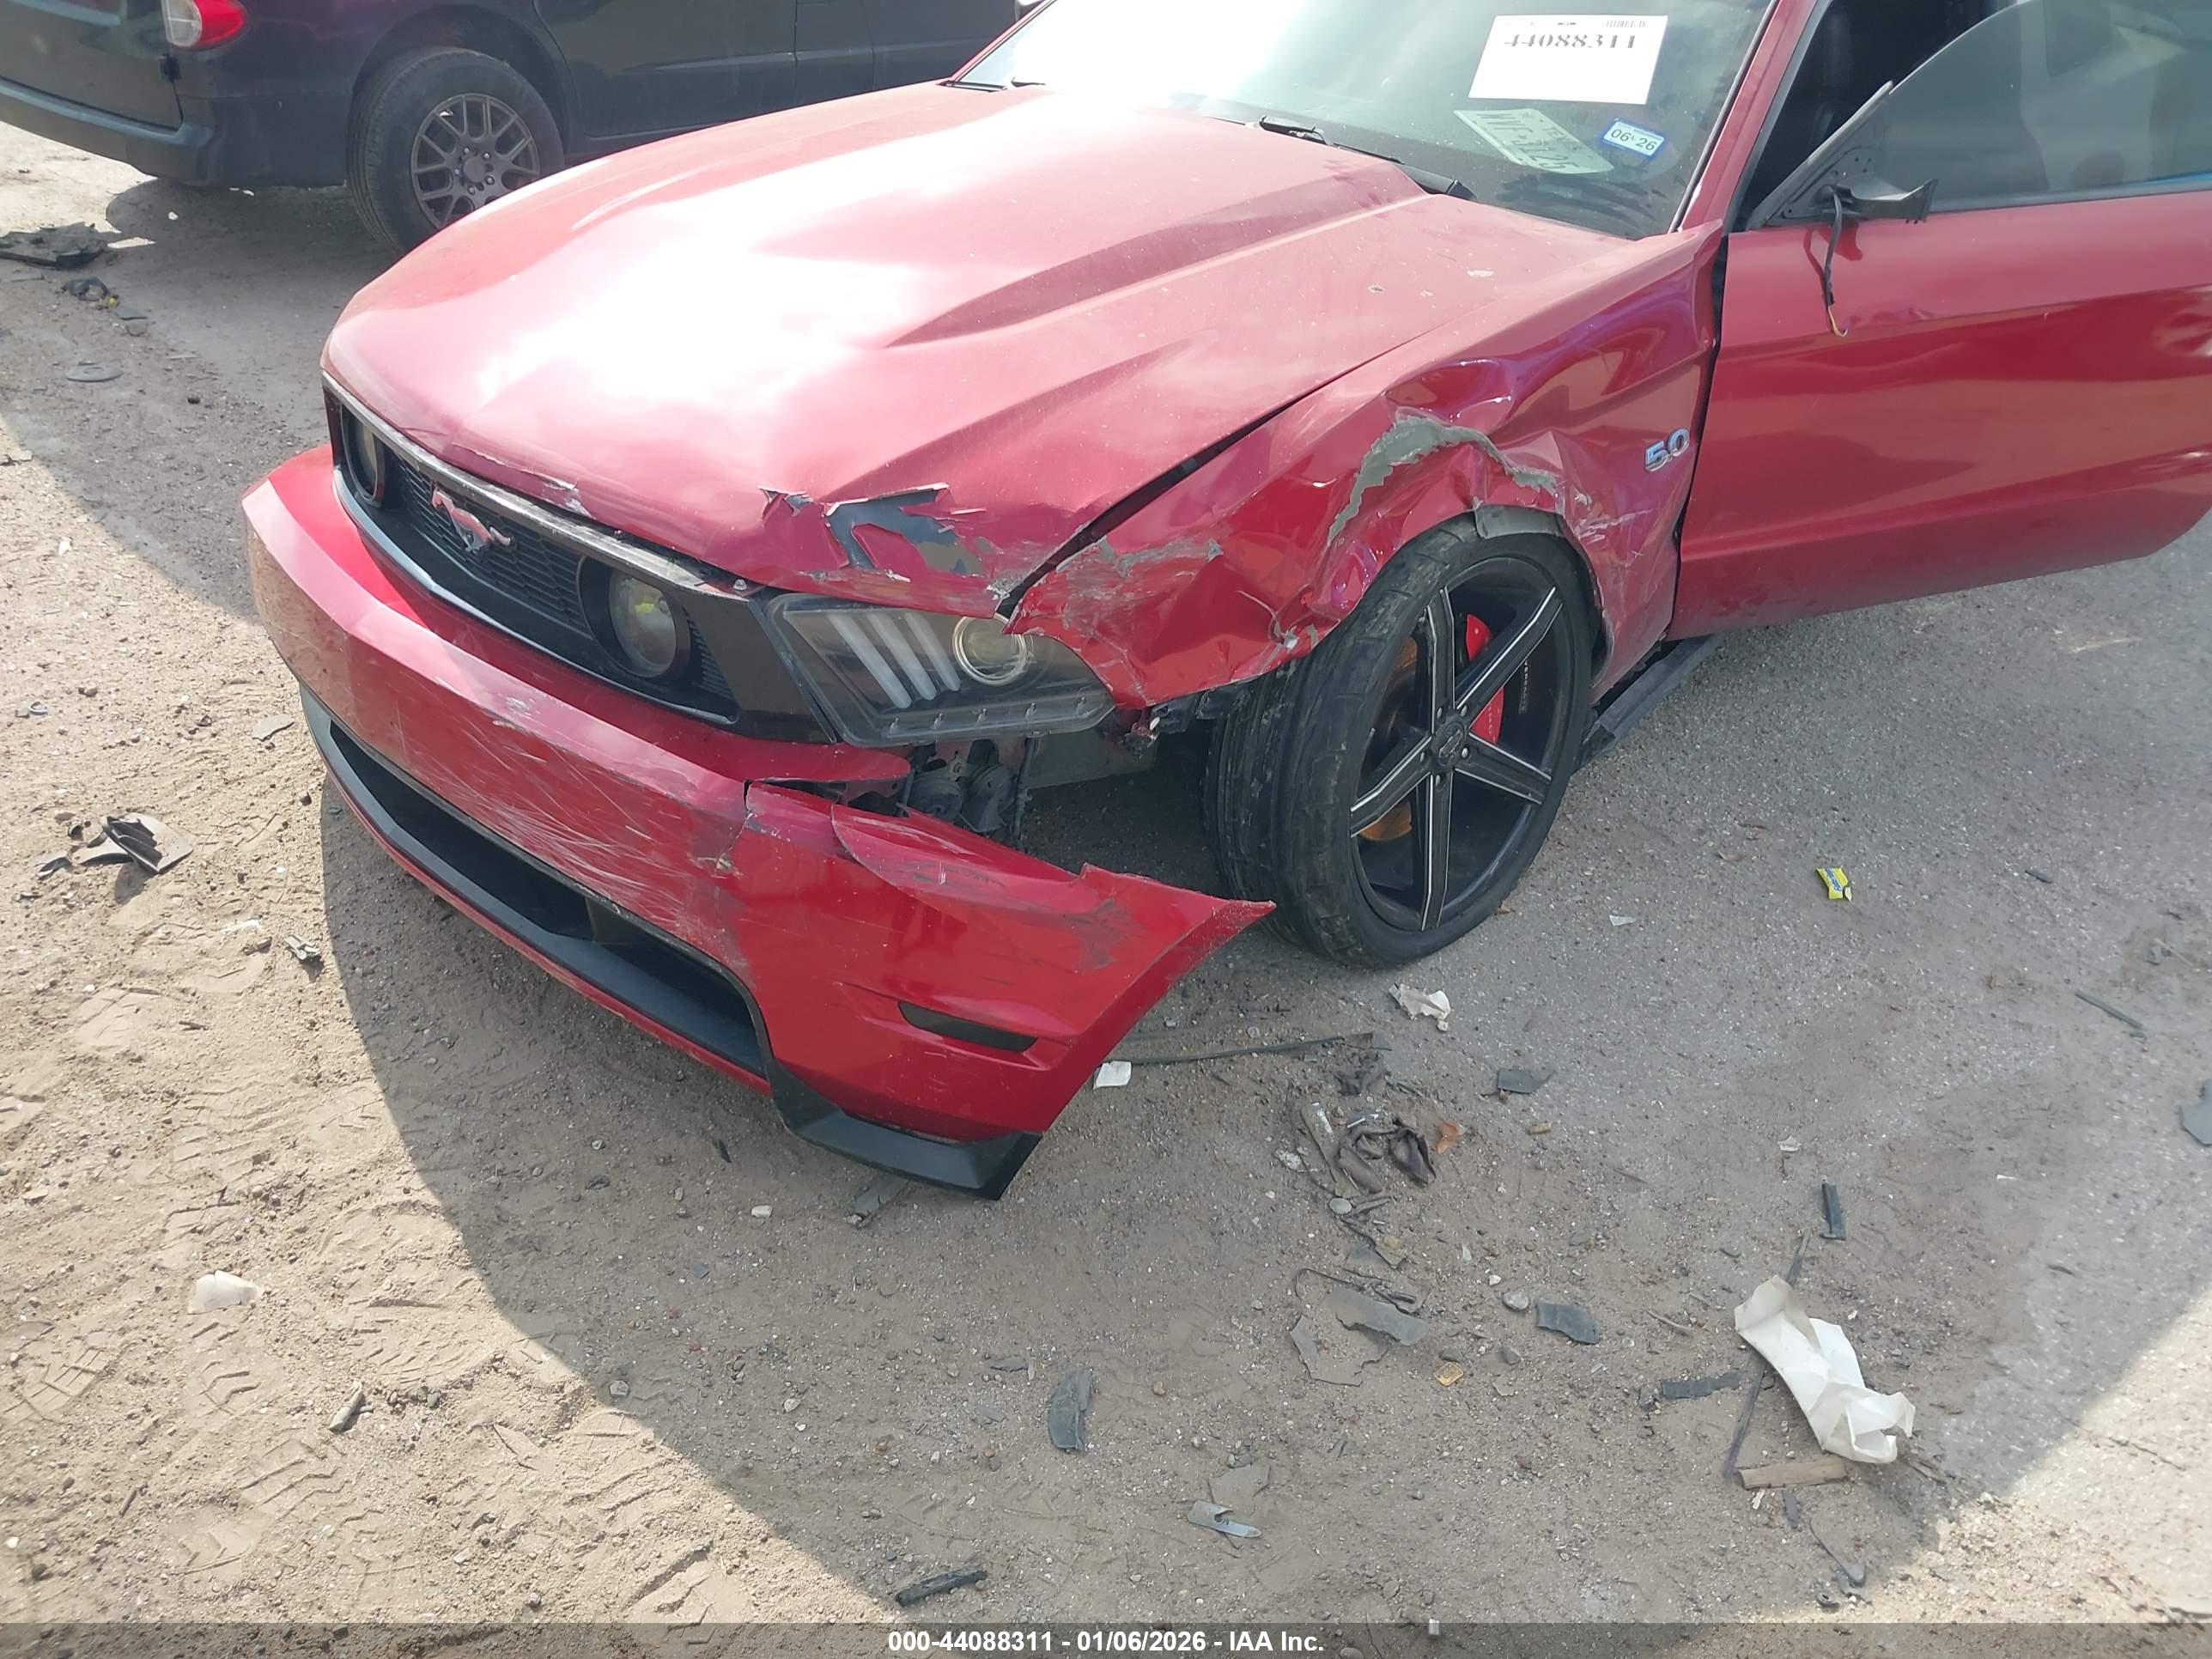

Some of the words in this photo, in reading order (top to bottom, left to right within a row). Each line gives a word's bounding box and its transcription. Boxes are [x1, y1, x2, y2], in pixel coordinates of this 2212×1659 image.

[1504, 33, 1635, 48] 44088311
[1611, 129, 1632, 142] 06
[1635, 137, 1657, 150] 26
